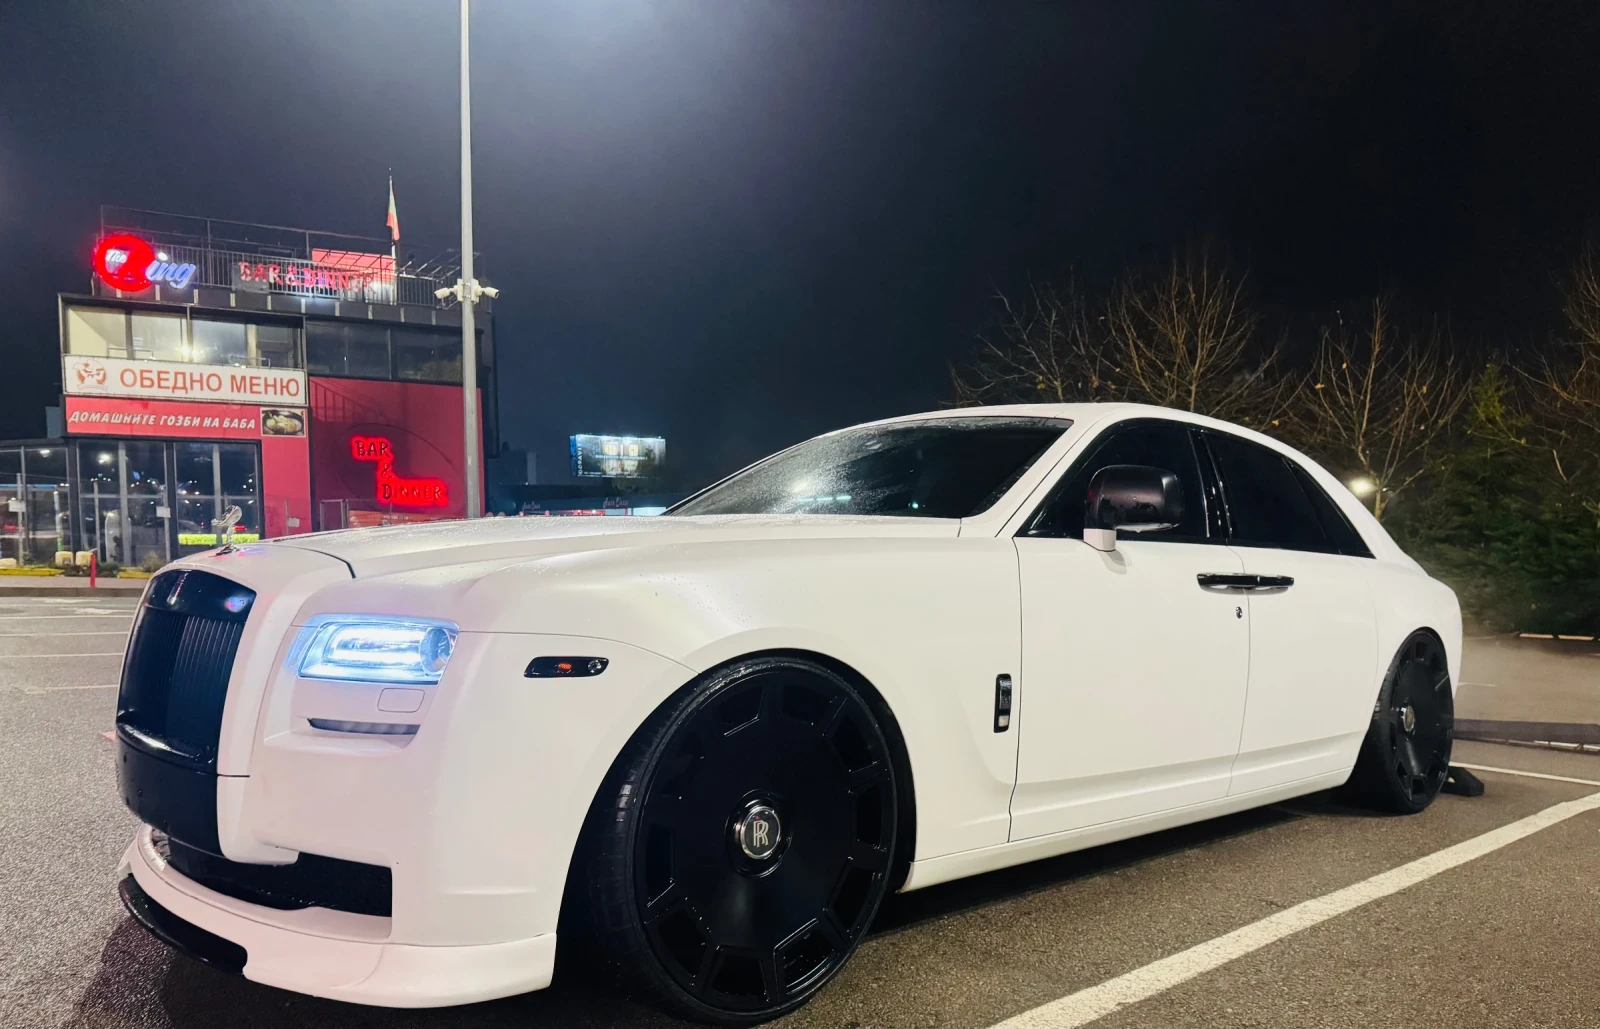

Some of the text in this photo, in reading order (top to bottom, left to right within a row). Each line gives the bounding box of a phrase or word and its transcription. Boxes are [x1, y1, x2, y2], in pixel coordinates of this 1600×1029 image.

[120, 368, 300, 397] ОБЕДНО МЕНЮ
[68, 410, 256, 429] ДОМАШНИТЕ ГОЗБИ НА БАБА
[355, 440, 391, 458] BAR
